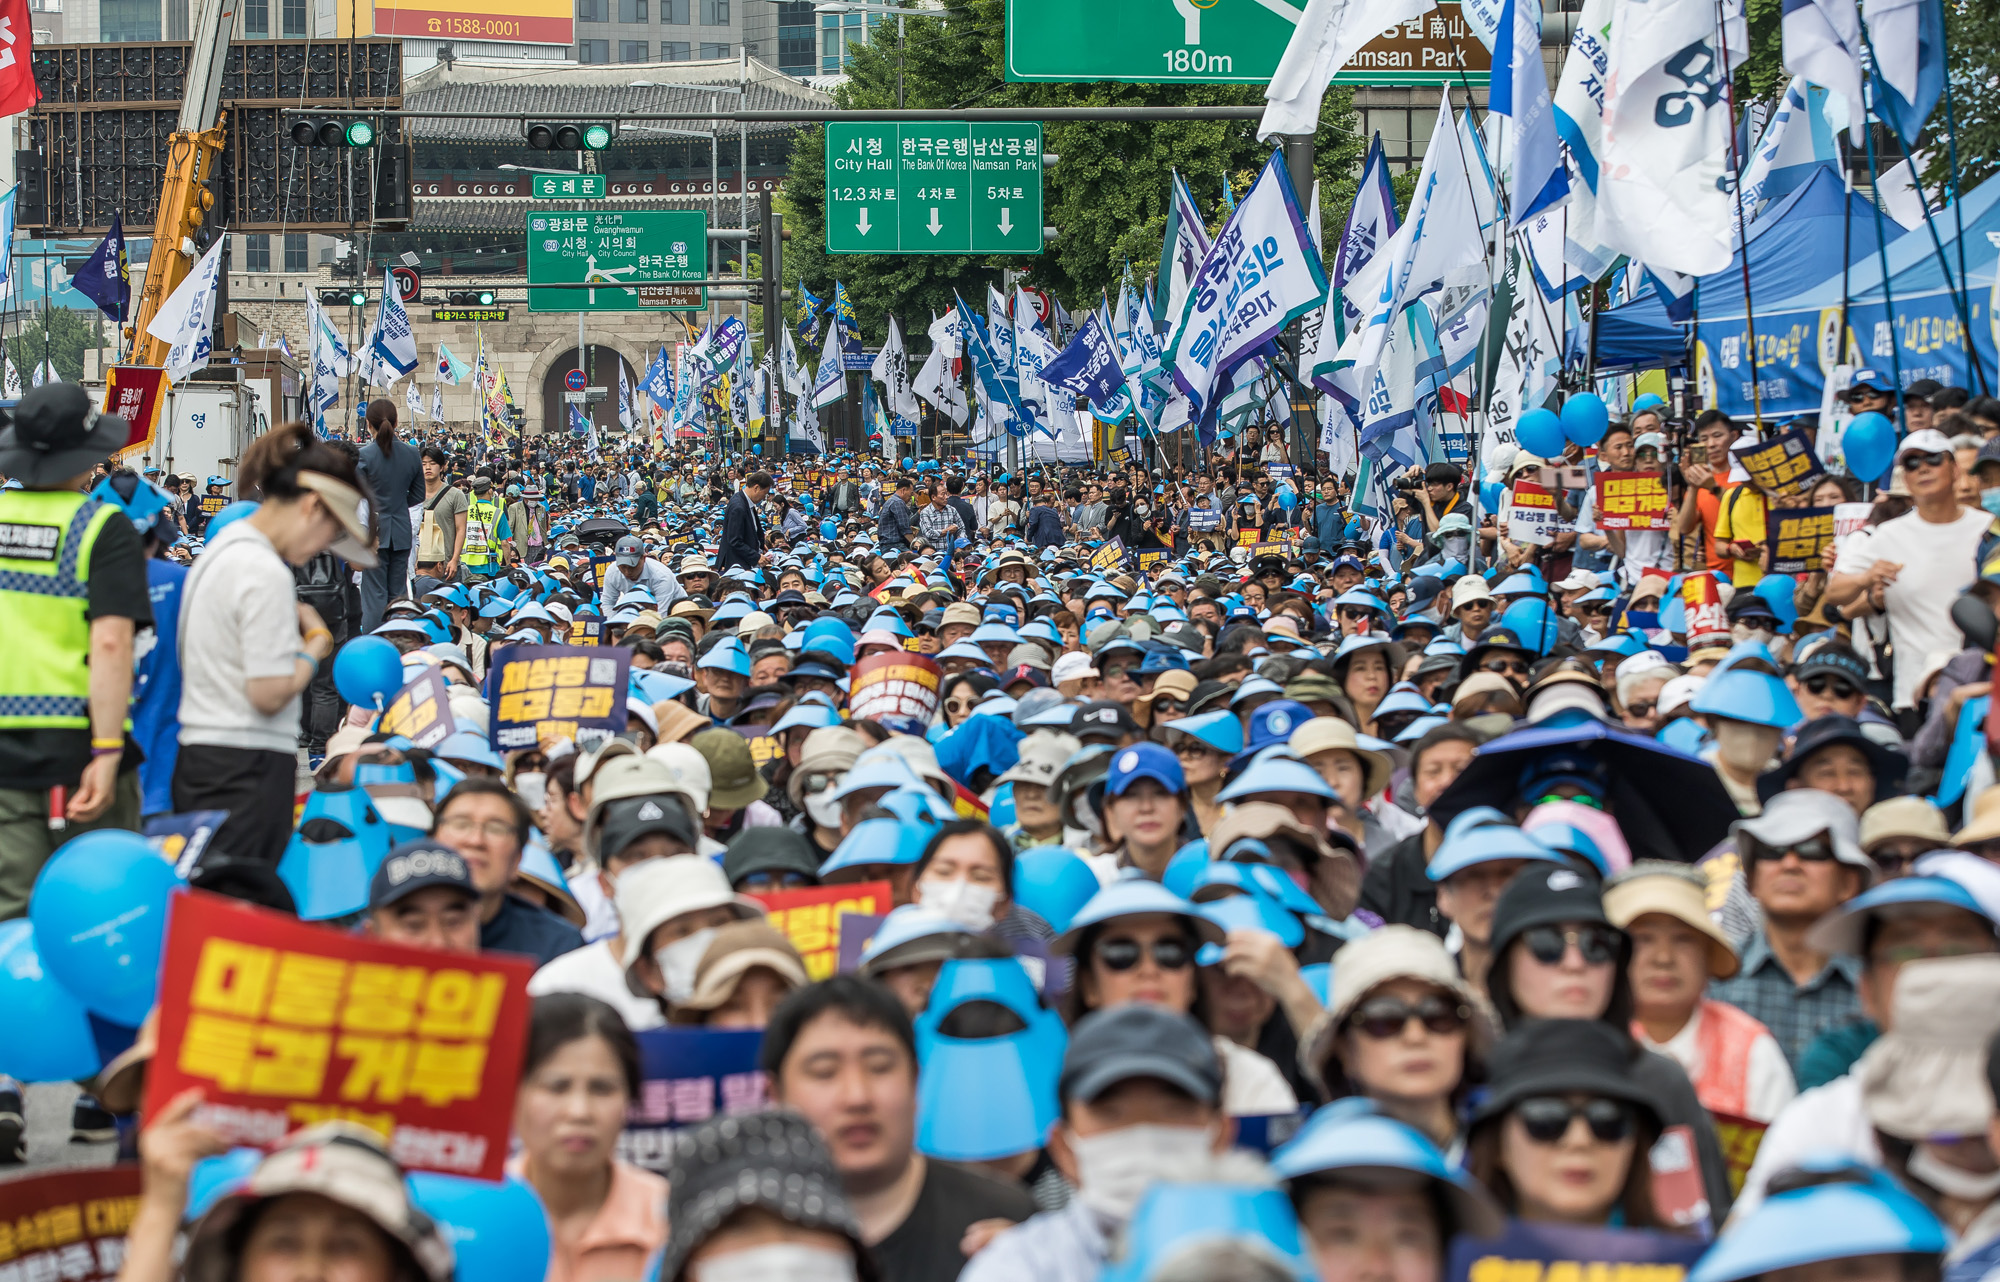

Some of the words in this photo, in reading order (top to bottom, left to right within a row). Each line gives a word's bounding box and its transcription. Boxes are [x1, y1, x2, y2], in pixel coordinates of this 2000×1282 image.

[445, 18, 520, 36] 1588-0001
[1162, 50, 1233, 73] 180m
[1347, 50, 1413, 67] amsan
[1422, 45, 1467, 67] Park
[847, 138, 882, 155] 시청
[902, 138, 968, 156] 한국은행
[973, 138, 1037, 156] 남산공원
[834, 158, 862, 173] City
[867, 158, 892, 170] Hall
[902, 158, 915, 170] The
[917, 158, 935, 170] Bank
[936, 158, 945, 170] Of
[946, 158, 967, 170] Korea
[973, 158, 1010, 170] Namsan
[1016, 158, 1037, 170] Park
[549, 218, 588, 232] 광화문
[595, 215, 623, 225] 光化門
[594, 226, 644, 234] Gwanghwamun
[599, 236, 637, 249] 시의회
[562, 250, 575, 258] City
[598, 250, 610, 258] City
[639, 255, 688, 268] 한국은행
[639, 270, 651, 278] The
[652, 270, 671, 278] Bank
[672, 270, 681, 278] Of
[682, 270, 701, 278] Korea
[640, 297, 669, 306] Namsan
[671, 297, 688, 305] Park
[436, 311, 467, 320] 배출가스
[469, 311, 505, 320] 5등급차량
[1604, 497, 1636, 513] 특검
[1638, 495, 1668, 512] 거부
[500, 656, 591, 694] 채상병
[498, 689, 552, 723] 특검
[551, 687, 615, 719] 통과
[386, 848, 467, 887] BOSS
[191, 935, 506, 1038] 대통령의
[176, 1012, 333, 1098] 특검
[335, 1036, 489, 1108] 거부
